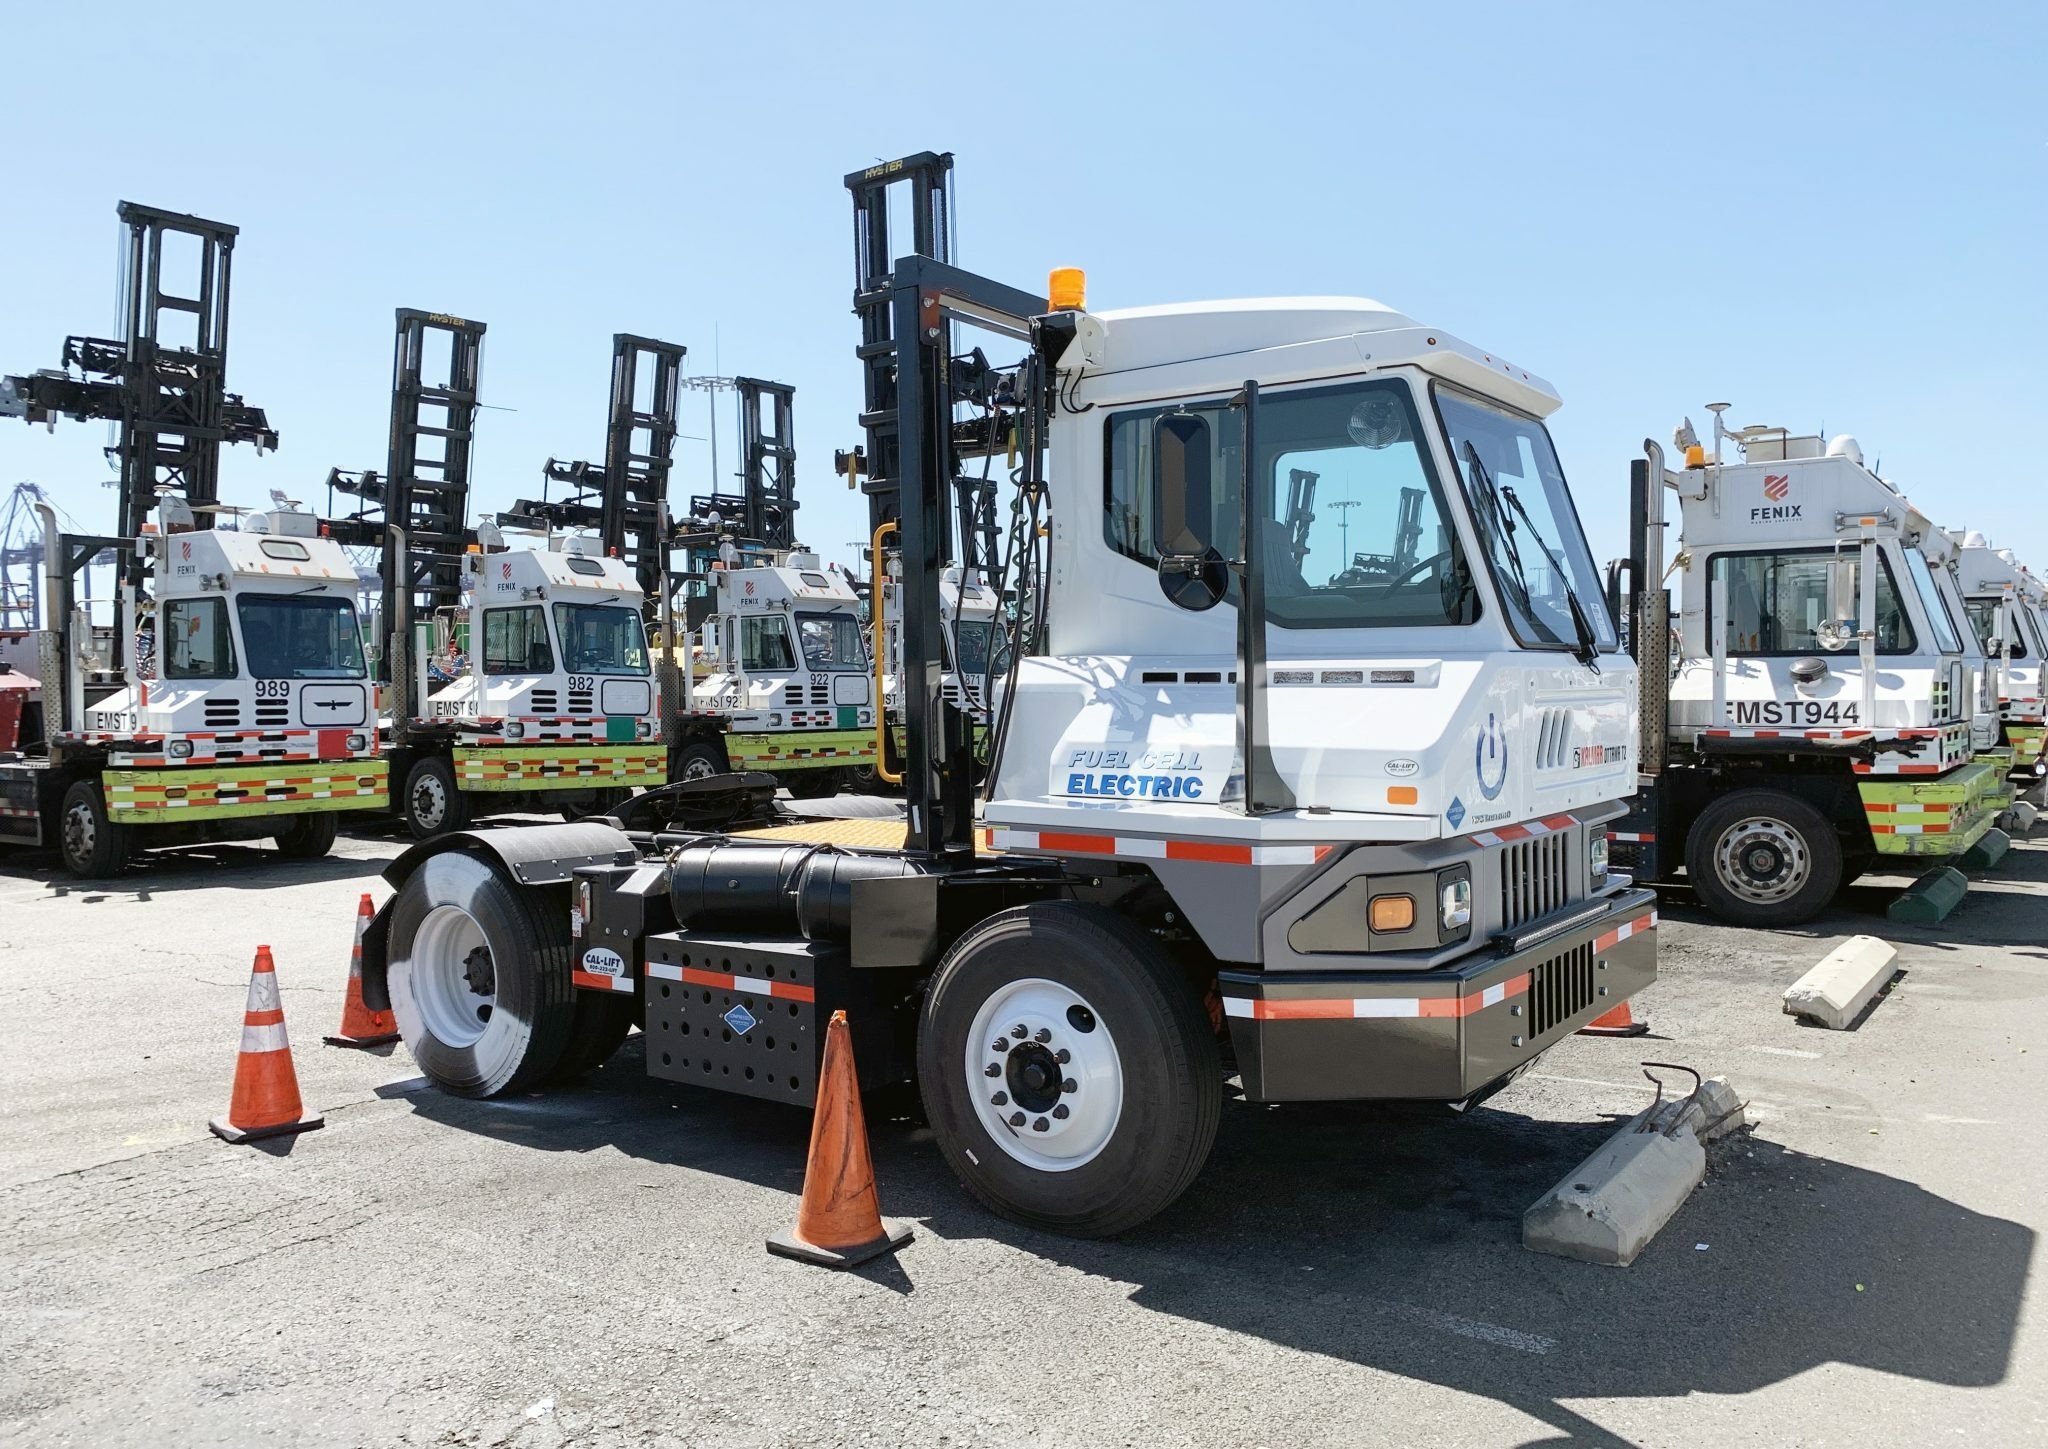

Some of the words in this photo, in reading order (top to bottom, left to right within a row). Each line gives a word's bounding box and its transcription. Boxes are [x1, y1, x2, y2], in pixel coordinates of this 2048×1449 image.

[865, 160, 903, 179] HYSTER
[429, 313, 466, 326] HYSTER
[1750, 505, 1802, 520] FENIX
[177, 565, 196, 575] FENIX
[497, 582, 516, 591] FENIX
[568, 677, 594, 691] 982
[810, 674, 829, 685] 922
[965, 675, 980, 685] 871
[255, 681, 290, 697] 989
[1068, 750, 1130, 769] FUEL
[1139, 752, 1203, 771] CELL
[1067, 773, 1204, 798] ELECTRIC
[586, 954, 620, 967] CAL-LIFT
